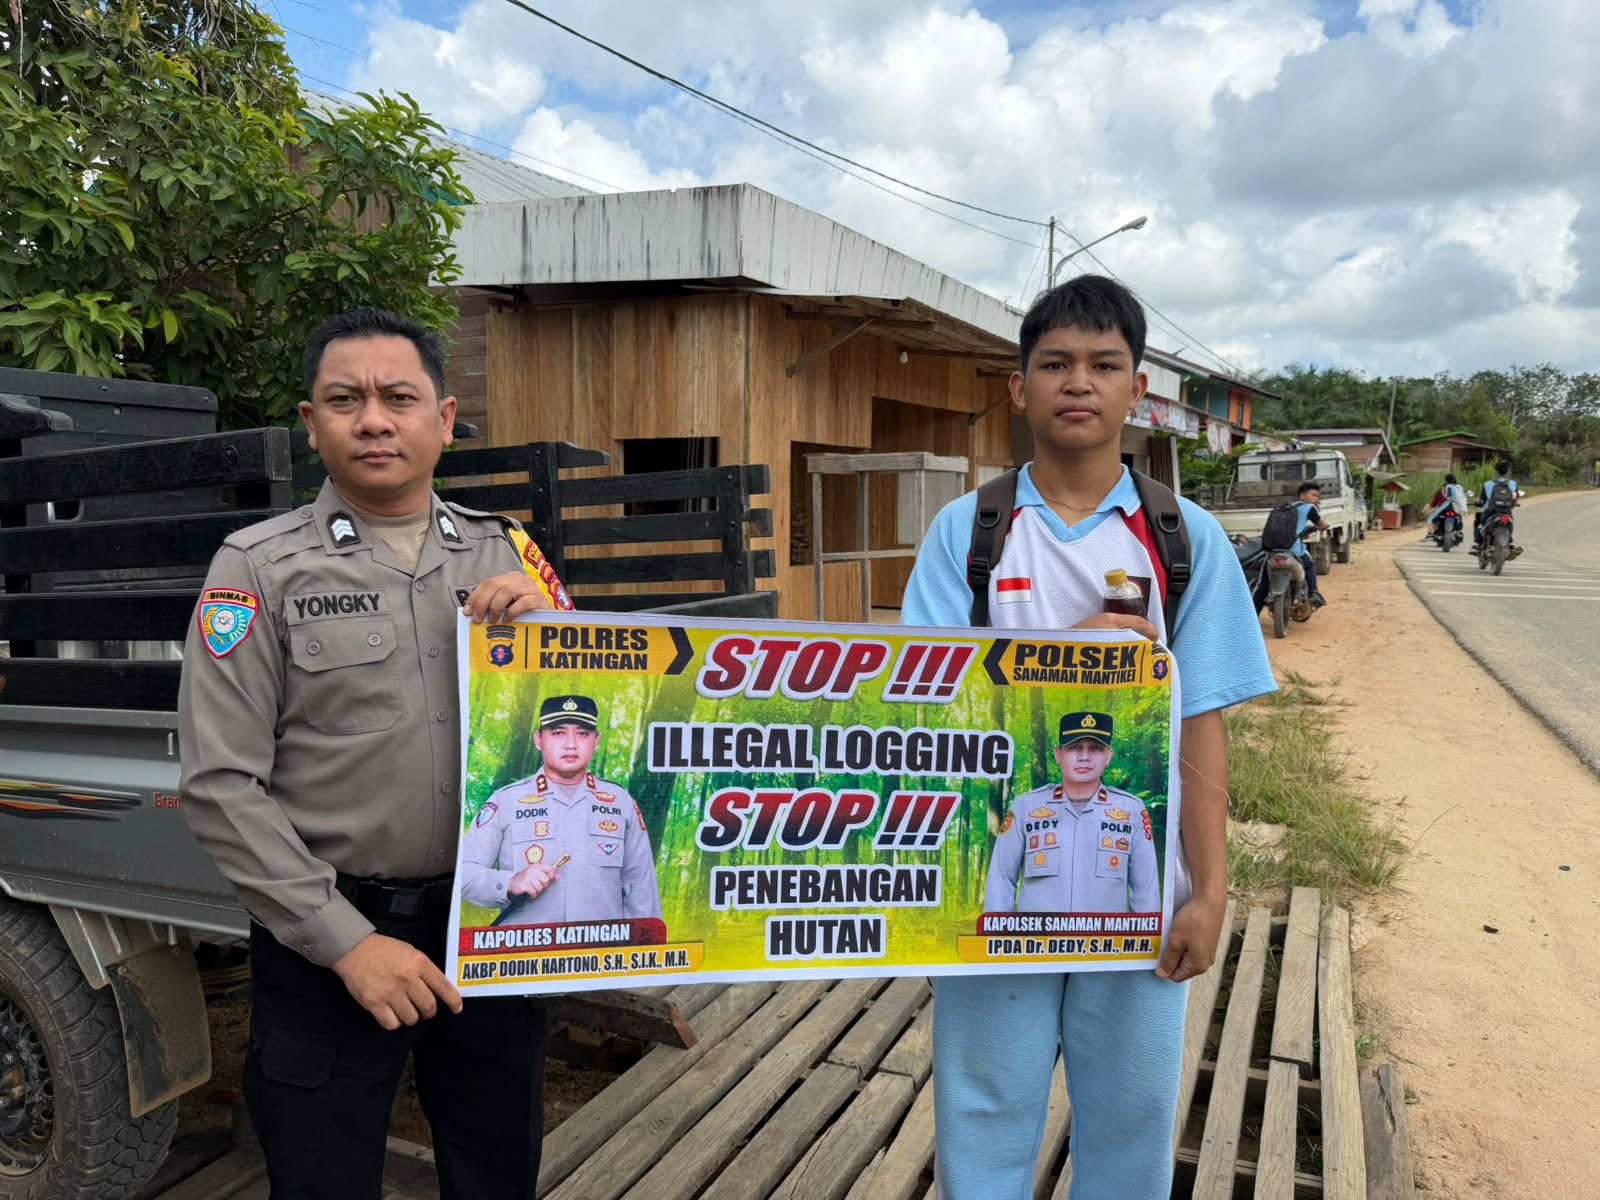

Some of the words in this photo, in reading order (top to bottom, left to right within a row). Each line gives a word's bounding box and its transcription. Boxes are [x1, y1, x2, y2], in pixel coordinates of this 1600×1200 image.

[293, 592, 381, 619] YONGKY
[540, 626, 649, 651] POLRES
[539, 651, 648, 670] KATINGAN
[701, 636, 887, 694] STOP
[888, 645, 977, 697] !!!
[1014, 643, 1139, 670] POLSEK
[1013, 666, 1078, 684] SANAMAN
[1080, 668, 1136, 685] MANTIKEI
[652, 726, 814, 769] ILLEGAL
[823, 729, 1010, 775] LOGGING
[515, 807, 549, 819] DODIK
[591, 804, 622, 816] POLRI
[699, 791, 876, 847] STOP
[877, 795, 958, 846] !!!
[1025, 819, 1059, 833] DEDY
[1100, 821, 1132, 834] POLRI
[713, 868, 938, 906] PENEBANGAN
[473, 926, 552, 950] KAPOLRES
[555, 923, 631, 945] KATINGAN
[769, 918, 882, 956] HUTAN
[983, 916, 1043, 932] KAPOLSEK
[1044, 916, 1102, 932] SANAMAN
[1103, 917, 1159, 932] MANTIKEI
[987, 939, 1022, 955] IPDA
[1025, 939, 1045, 954] Dr.
[1048, 939, 1087, 955] DEDY,
[1089, 938, 1120, 955] S.H.,
[1122, 938, 1153, 953] M.H.
[462, 961, 497, 980] AKBP
[499, 958, 539, 977] DODIK
[541, 955, 602, 975] HARTONO,
[603, 953, 629, 972] S.H.,
[664, 950, 689, 967] M.H.
